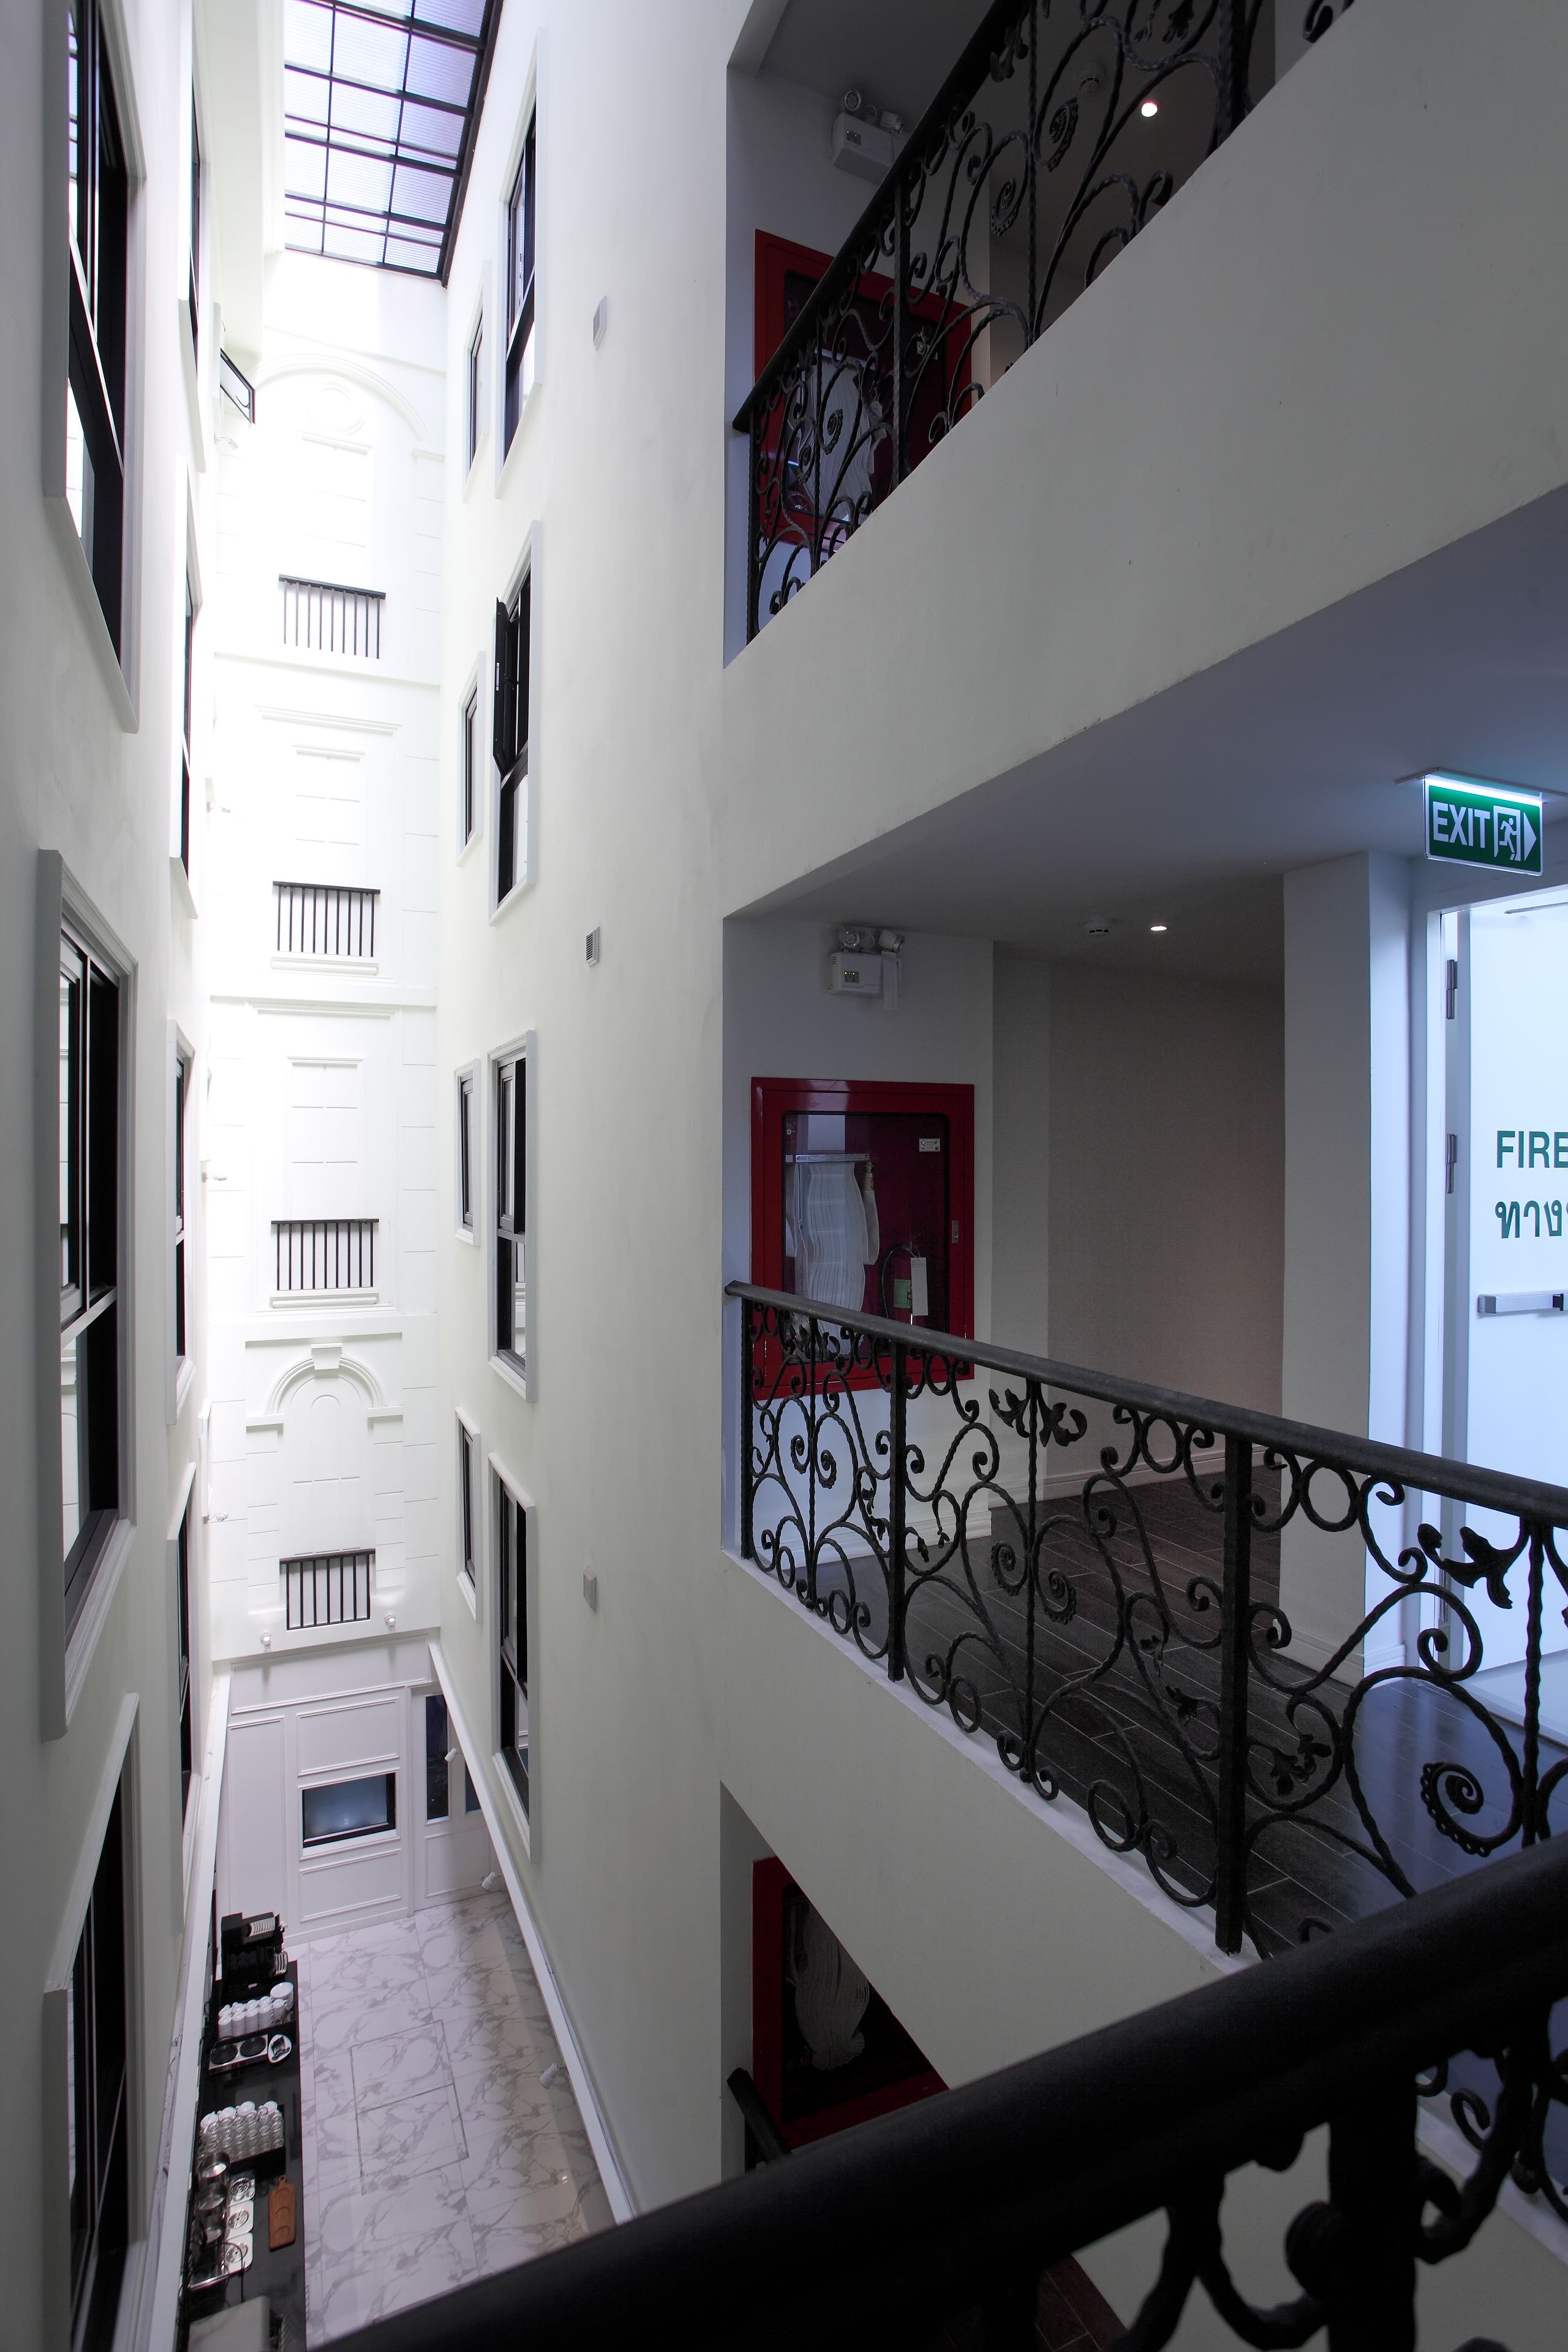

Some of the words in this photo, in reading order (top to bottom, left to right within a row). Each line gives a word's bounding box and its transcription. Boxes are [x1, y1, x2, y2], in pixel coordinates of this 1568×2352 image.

[1433, 801, 1490, 849] EXIT
[1496, 1130, 1568, 1168] FIRE
[1494, 1199, 1568, 1239] ทาง
